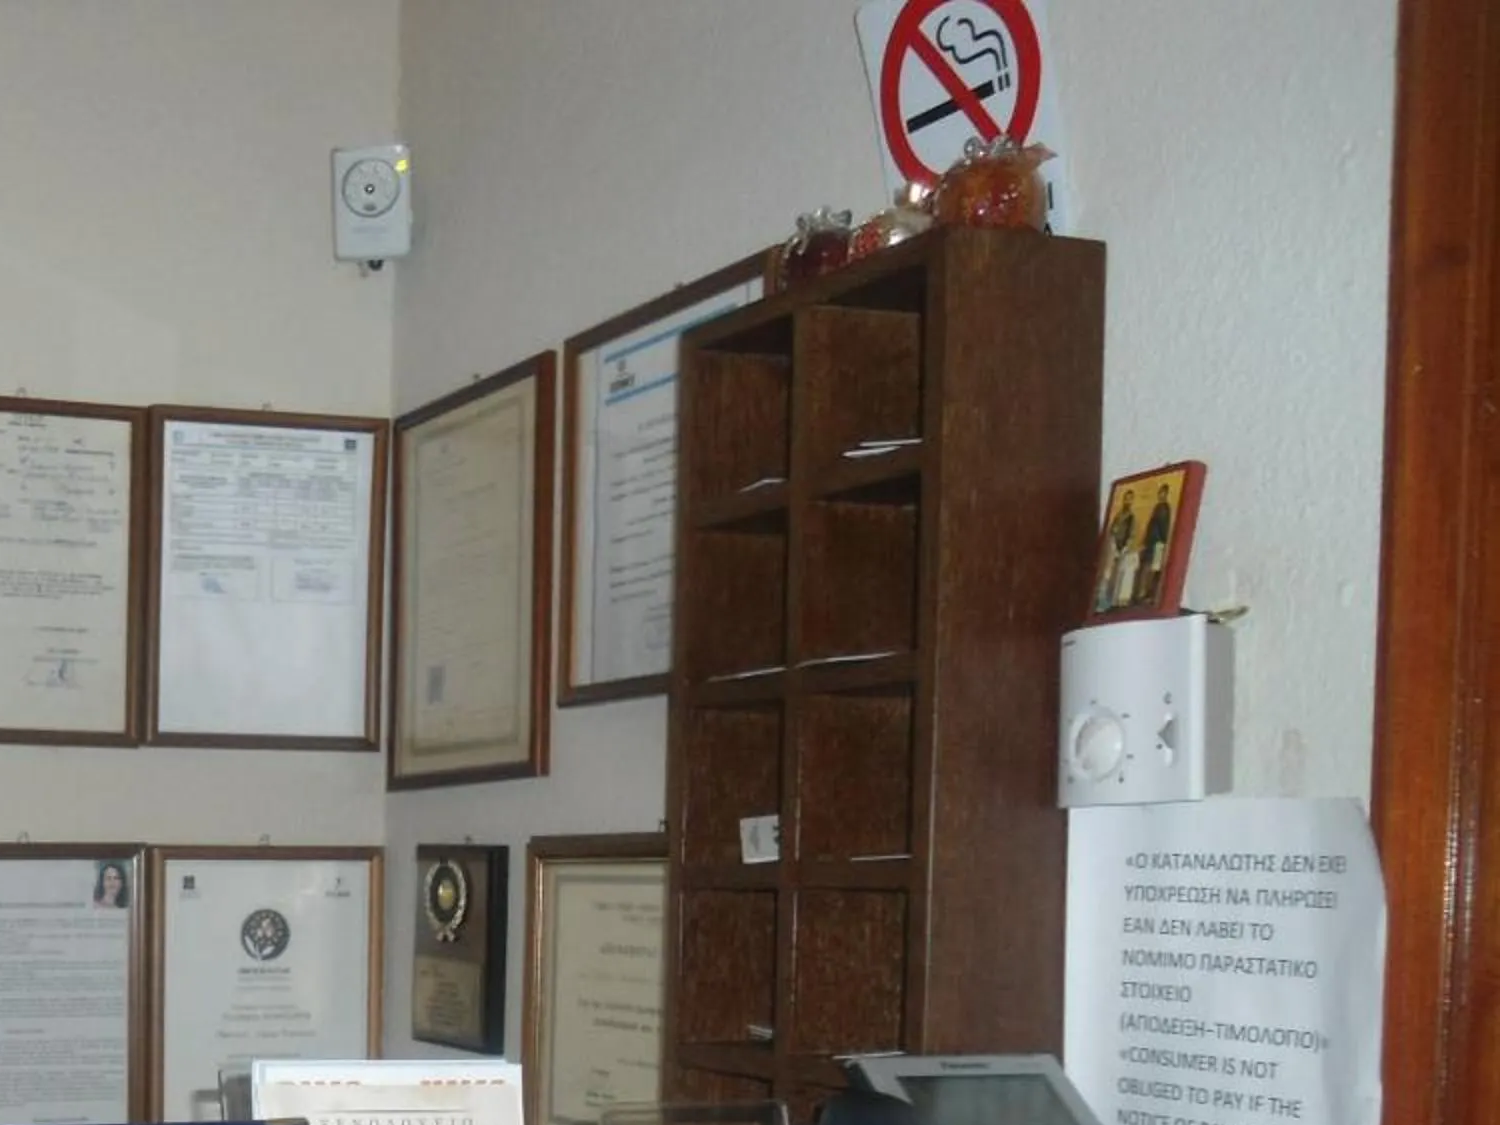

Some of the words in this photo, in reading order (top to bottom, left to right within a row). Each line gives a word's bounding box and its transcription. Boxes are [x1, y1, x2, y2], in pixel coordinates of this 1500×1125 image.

[1151, 853, 1277, 872] ΚΑΤΑΝΑΛΩΤΗΣ
[1281, 855, 1315, 873] ΔΕΝ
[1124, 884, 1221, 904] ΥΠΟΧΡΕΩΣΗ
[1225, 887, 1251, 906] ΝΑ
[1123, 917, 1155, 934] ΕΑΝ
[1158, 918, 1191, 936] ΔΕΝ
[1195, 920, 1244, 939] ΛΑΒΕΙ
[1249, 922, 1275, 941] ΤΟ
[1121, 948, 1197, 971] ΝΟΜΙΜΟ
[1200, 952, 1318, 979] ΠΑΡΑΣΤΑΤΙΚΟ
[1120, 981, 1192, 1002] ΣΤΟΙΧΕΙΟ
[1221, 1056, 1236, 1076] IS
[1240, 1059, 1280, 1080] NOT
[1117, 1076, 1183, 1101] OBLIGED
[1187, 1085, 1209, 1105] TO
[1212, 1089, 1245, 1111] PAY
[1249, 1095, 1265, 1112] IF
[1268, 1097, 1304, 1119] THE
